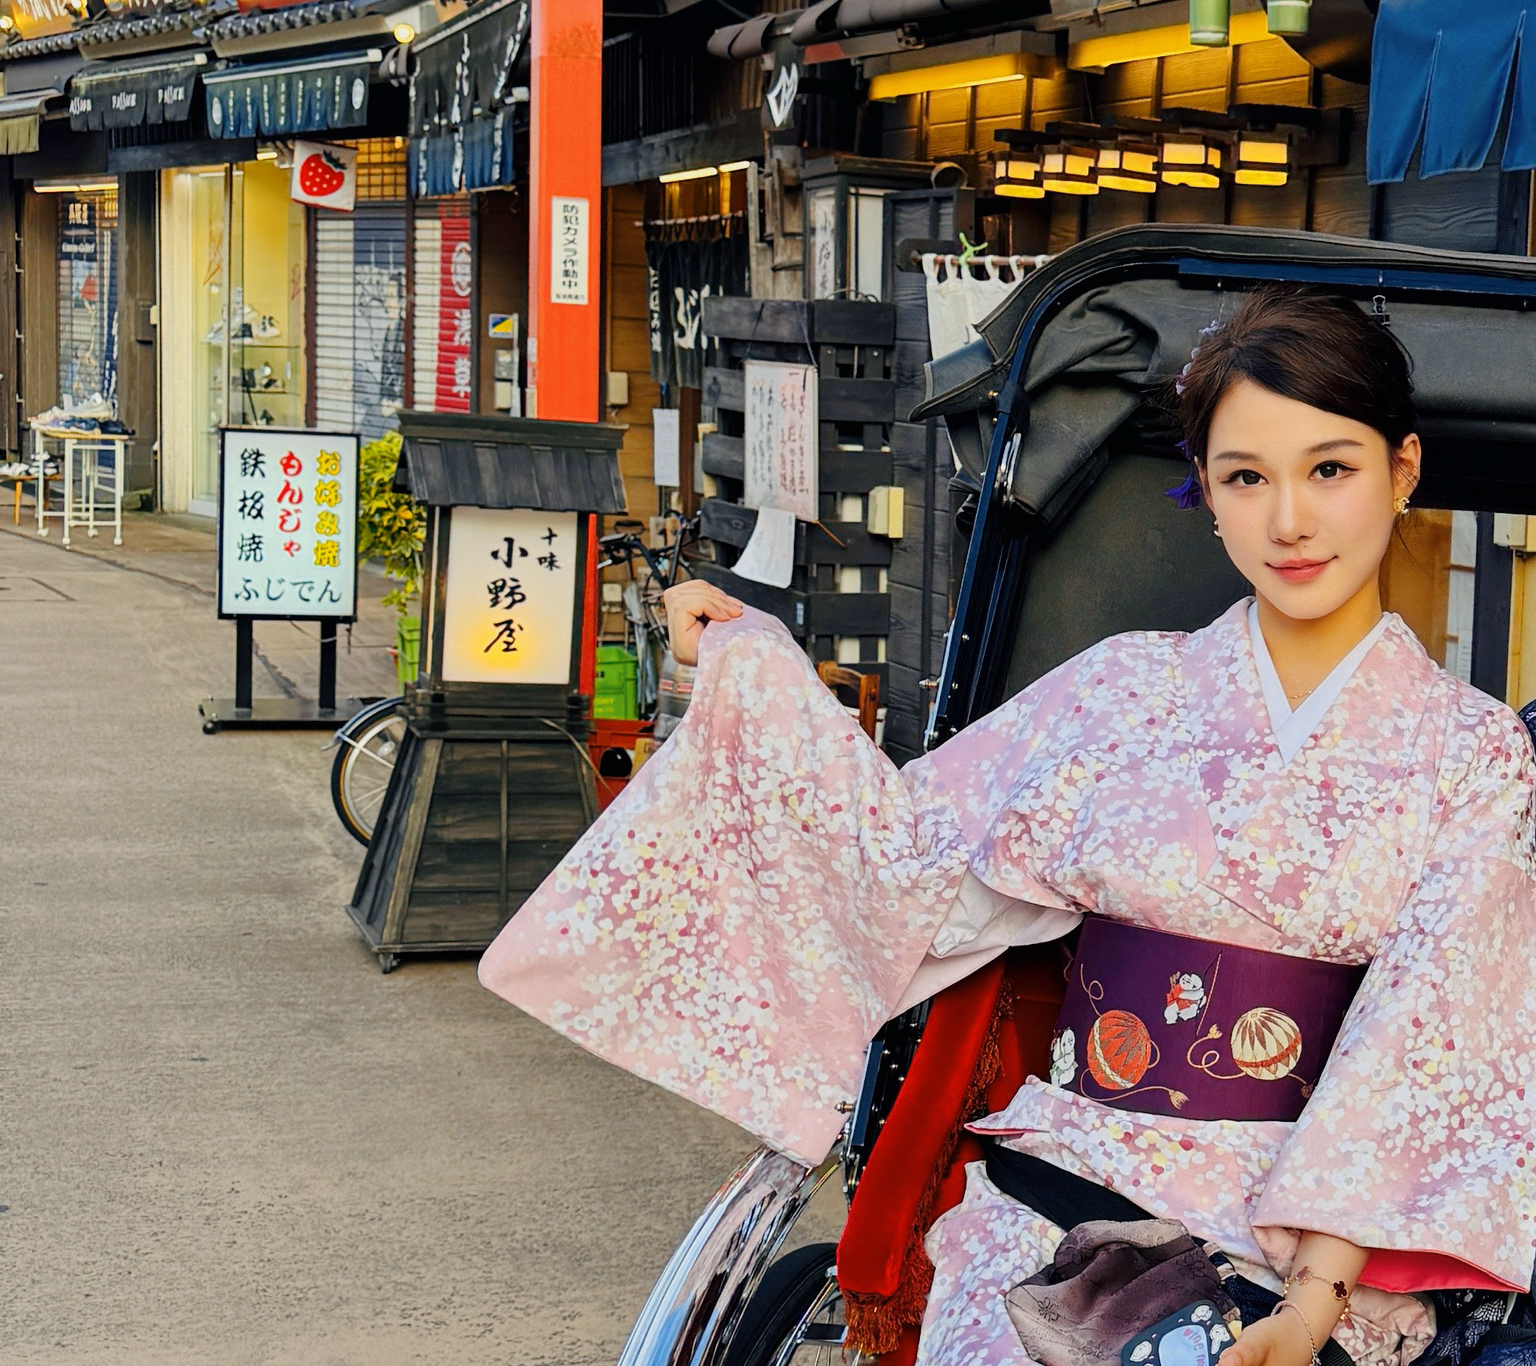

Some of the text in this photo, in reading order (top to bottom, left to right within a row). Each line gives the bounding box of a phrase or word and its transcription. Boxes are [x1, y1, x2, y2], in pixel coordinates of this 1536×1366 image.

[562, 204, 579, 289] 防犯カメラ作動中
[237, 448, 266, 563] 鉄板焼
[276, 451, 303, 557] もんじゃ
[313, 449, 342, 568] お好み焼
[537, 527, 561, 571] 十味
[234, 577, 342, 603] ふじでん
[483, 536, 529, 653] 小野屋
